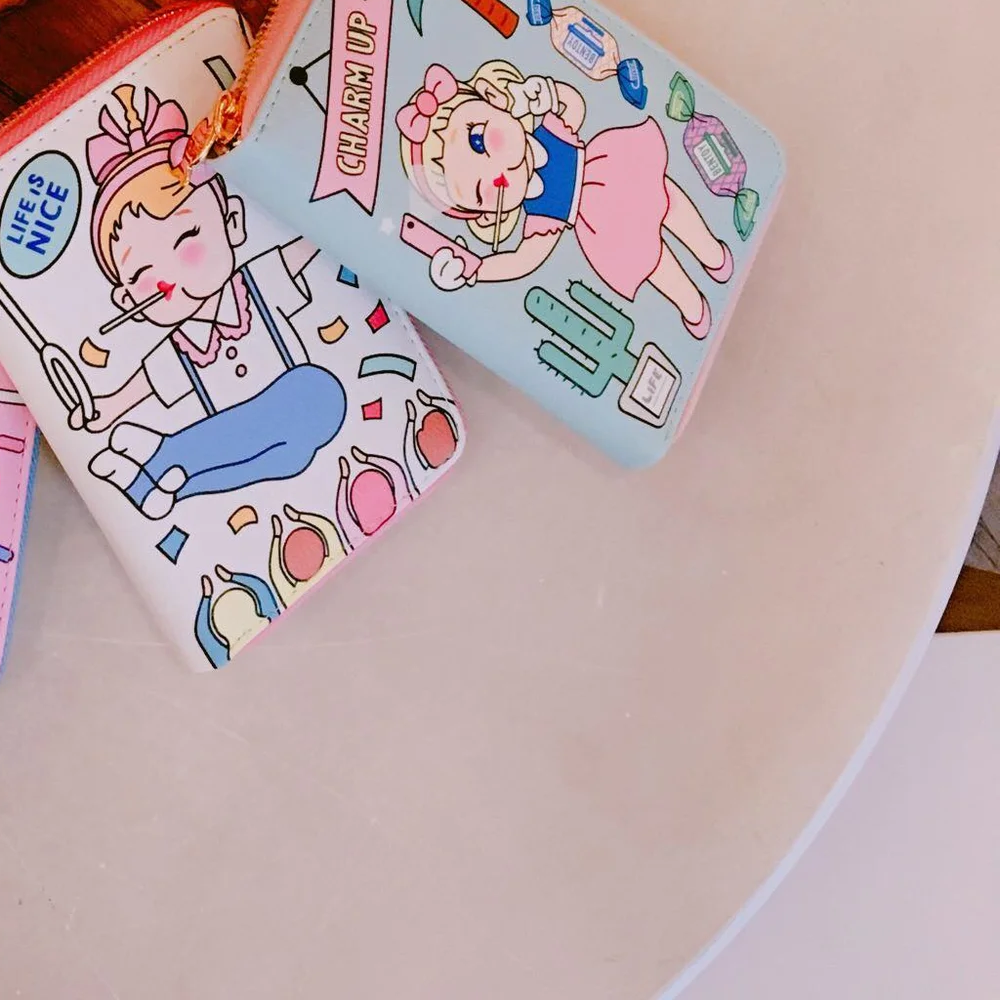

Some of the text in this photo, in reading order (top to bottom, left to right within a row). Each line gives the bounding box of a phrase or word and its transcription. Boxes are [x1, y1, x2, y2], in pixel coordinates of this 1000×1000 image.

[567, 36, 597, 65] BENTOY
[336, 11, 377, 176] CHARM UP
[6, 173, 45, 245] LIFE IS
[25, 181, 70, 256] NICE
